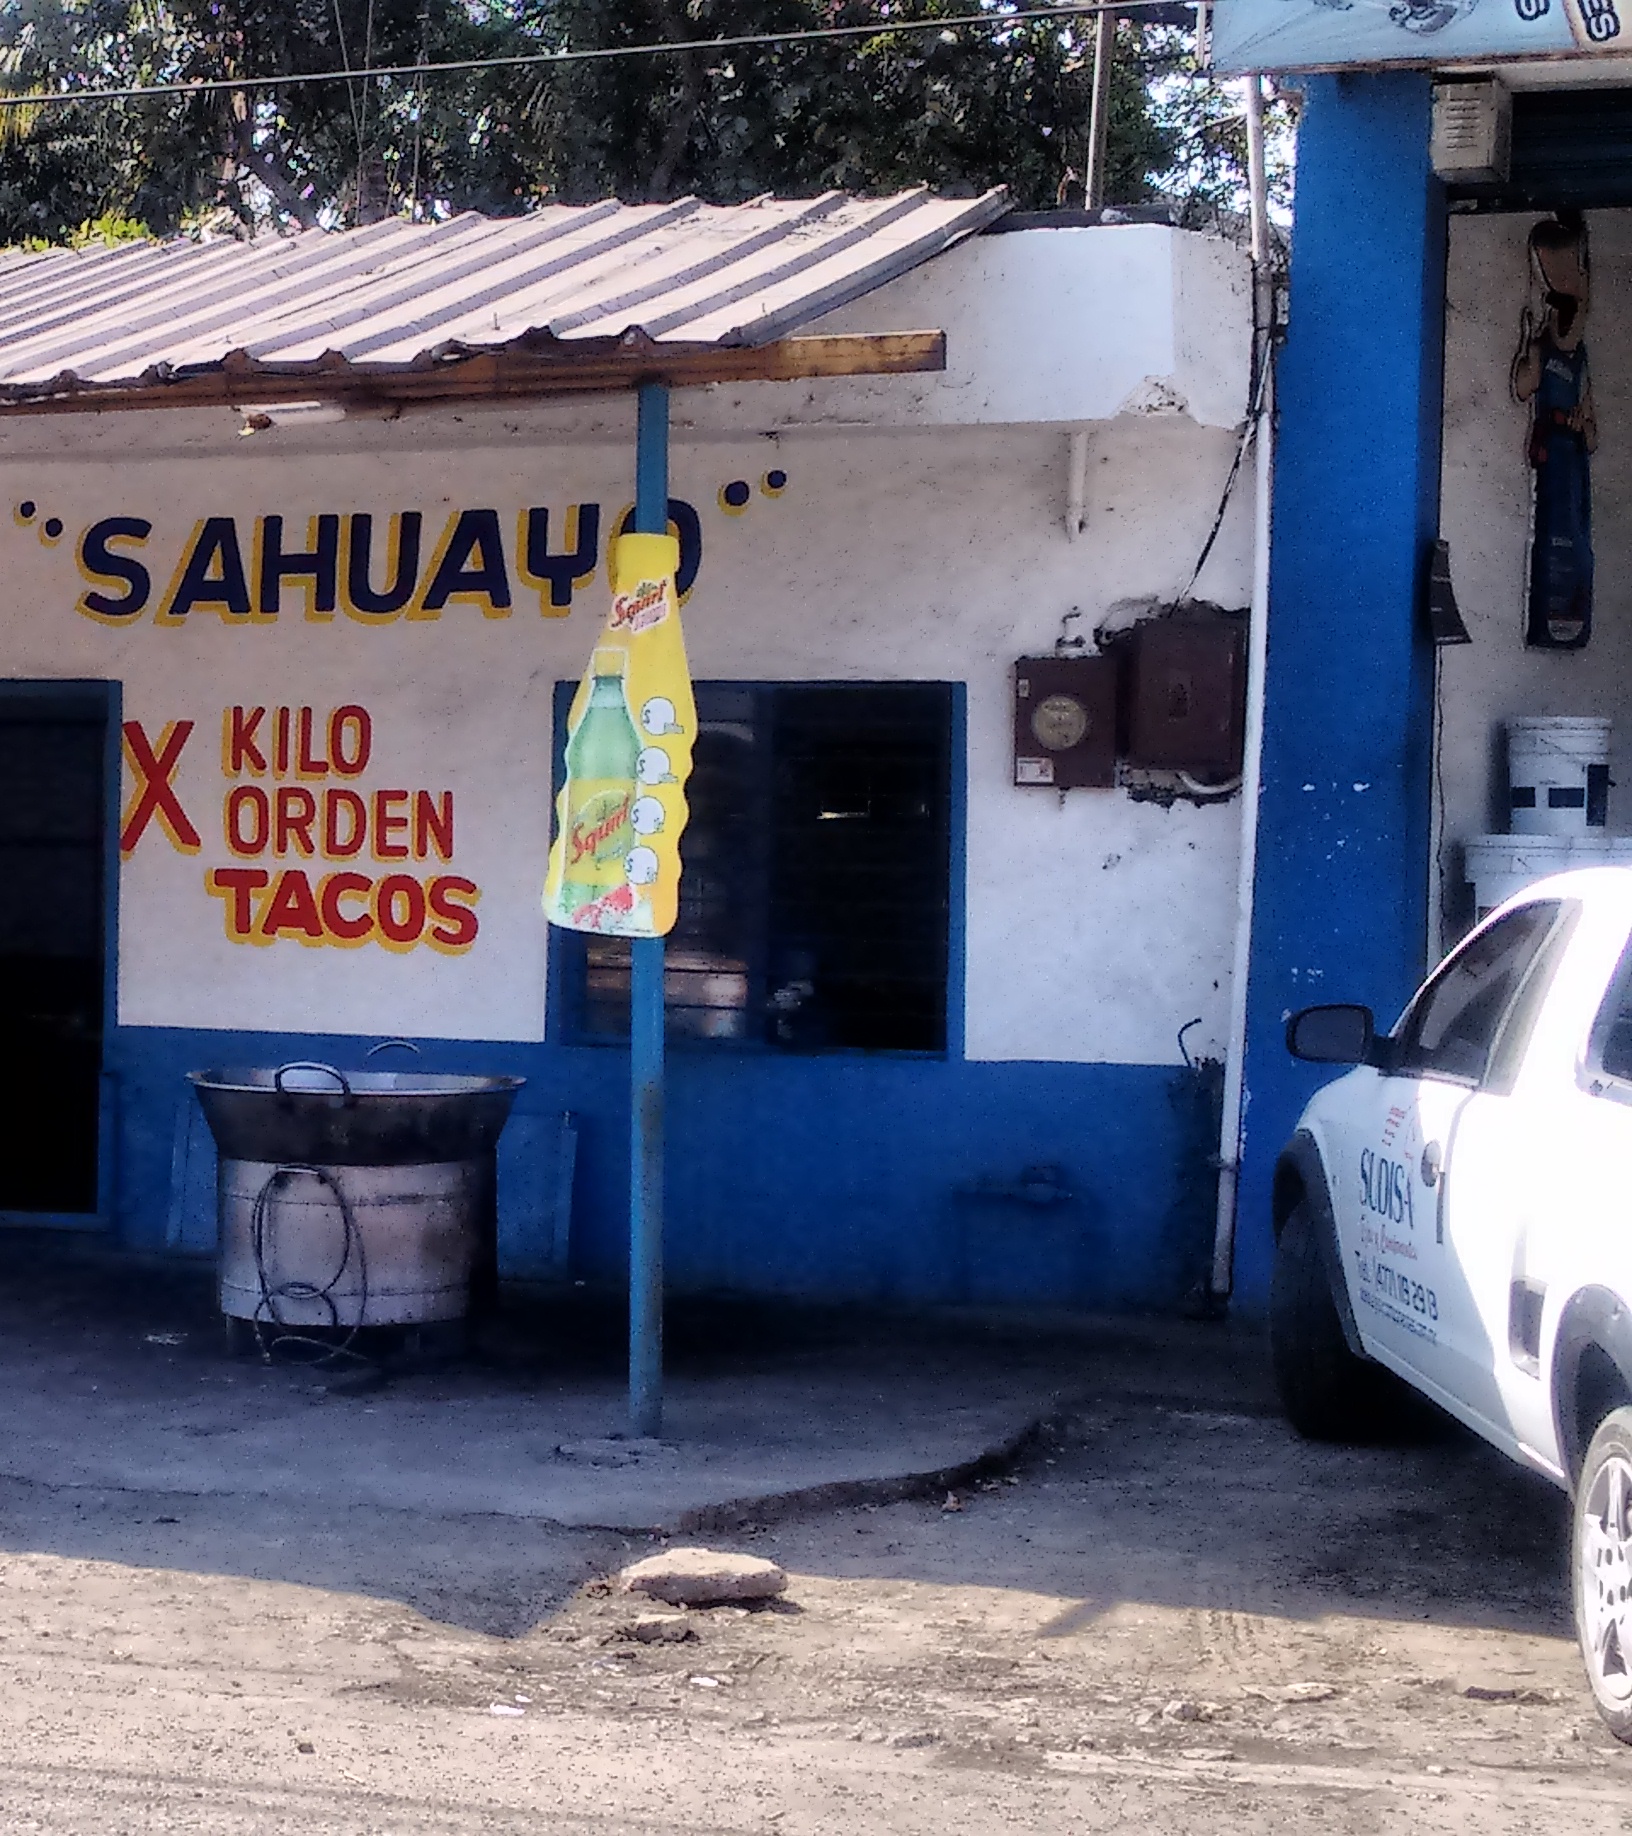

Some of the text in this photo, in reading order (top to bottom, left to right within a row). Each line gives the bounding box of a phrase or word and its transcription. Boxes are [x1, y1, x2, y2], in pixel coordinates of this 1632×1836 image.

[222, 704, 372, 779] KILO
[121, 719, 202, 860] X
[223, 785, 454, 861] ORDEN
[571, 794, 630, 864] Squirt
[206, 867, 481, 957] TACOS
